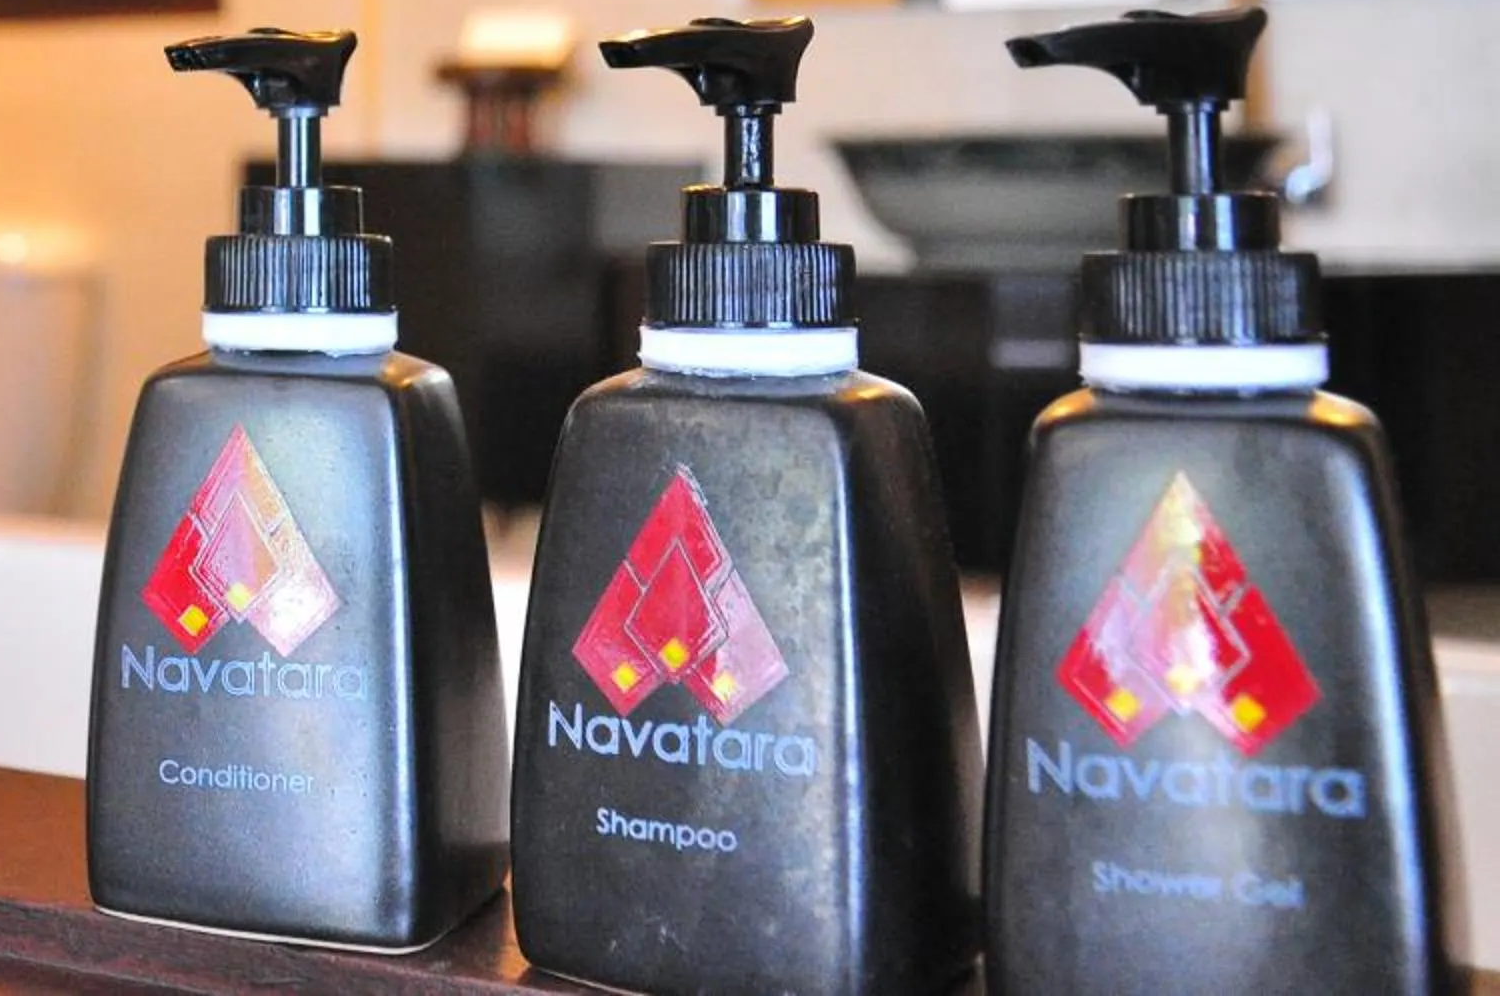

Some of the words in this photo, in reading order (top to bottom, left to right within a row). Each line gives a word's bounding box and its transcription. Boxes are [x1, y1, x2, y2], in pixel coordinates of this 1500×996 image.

[121, 644, 368, 699] Navatara
[548, 700, 816, 777] Navatara
[159, 759, 315, 794] Conditioner
[1026, 737, 1367, 820] Navatara
[596, 808, 739, 852] Shampoo
